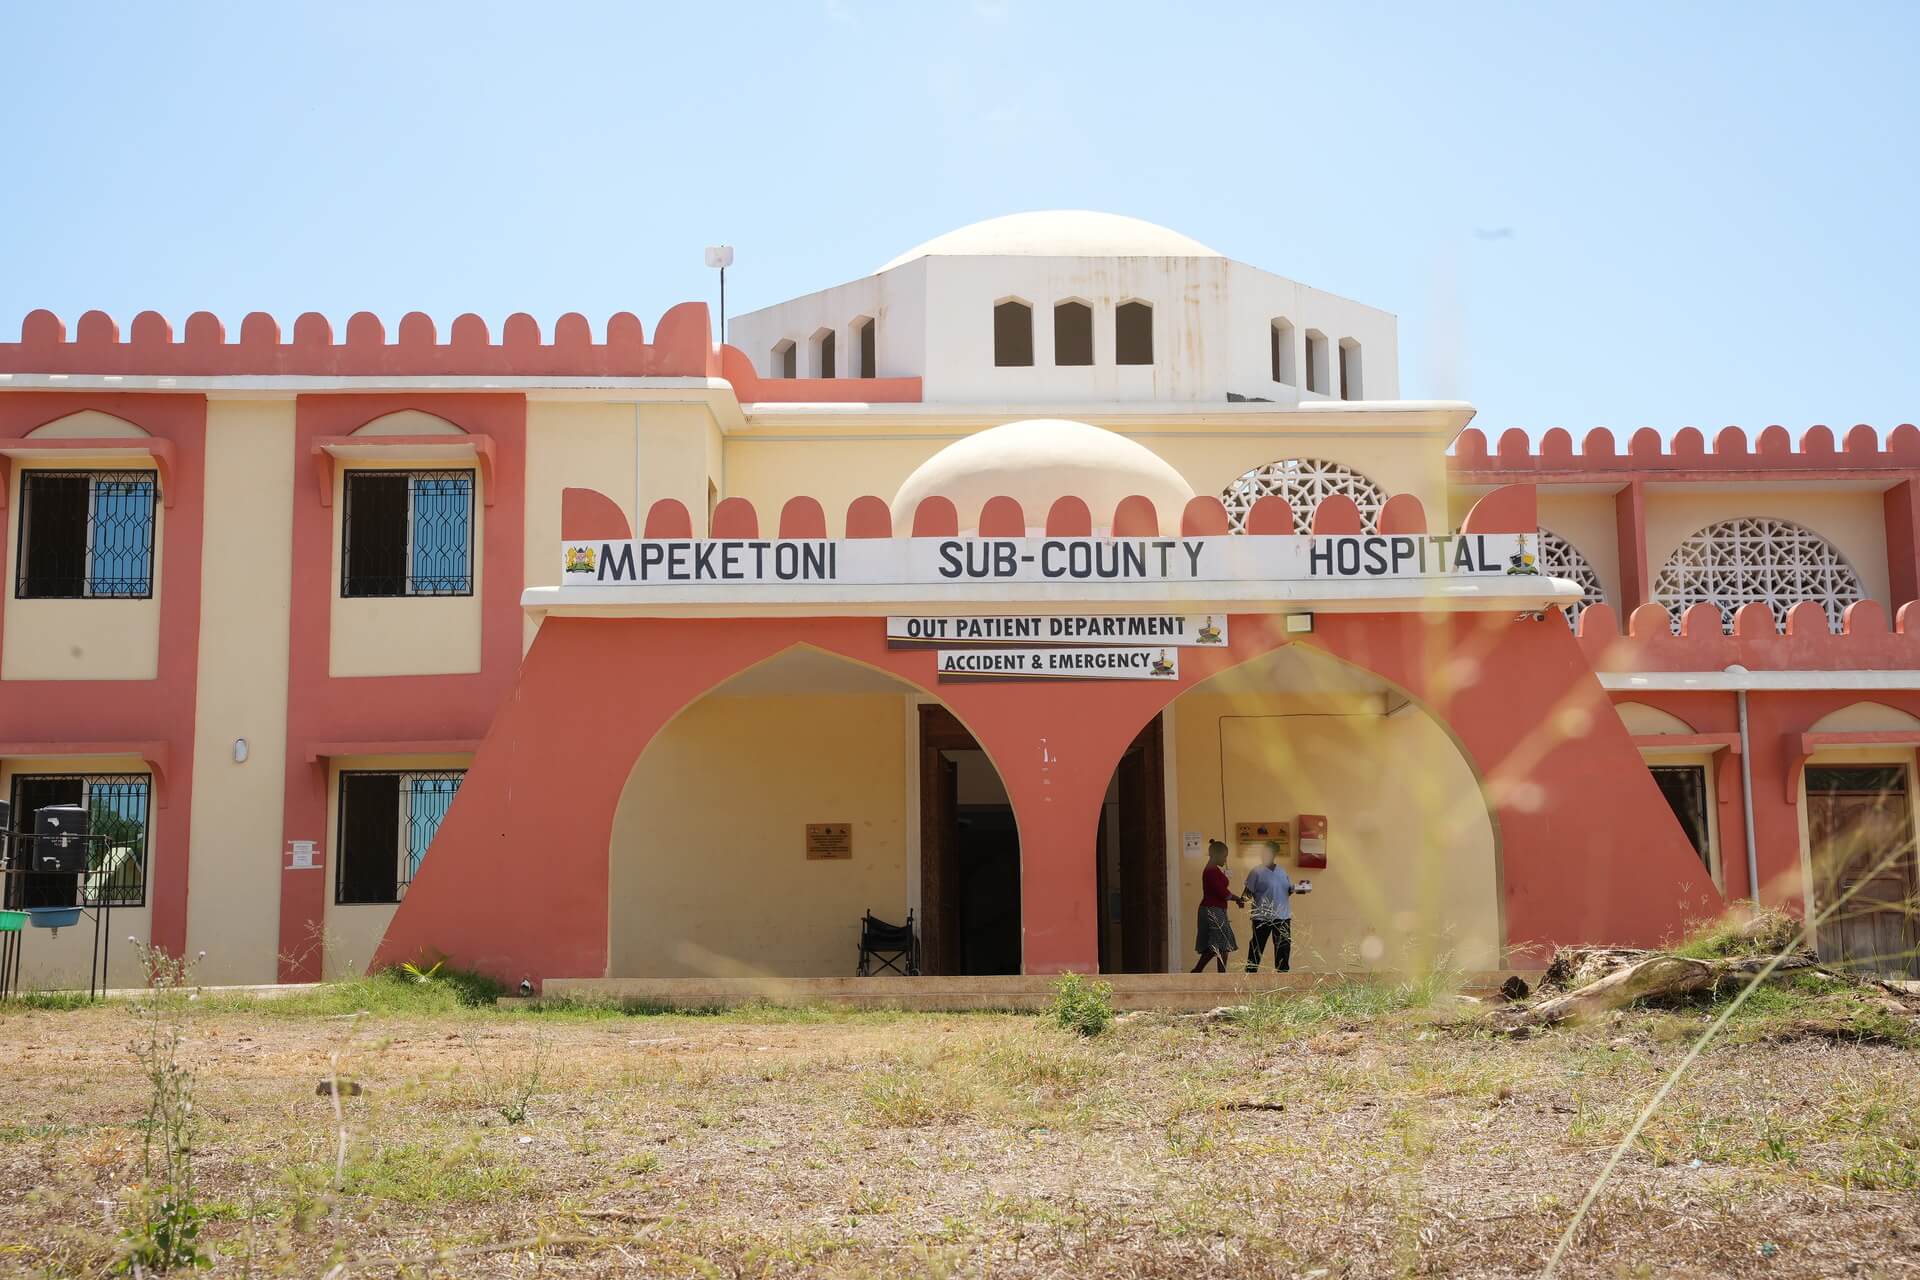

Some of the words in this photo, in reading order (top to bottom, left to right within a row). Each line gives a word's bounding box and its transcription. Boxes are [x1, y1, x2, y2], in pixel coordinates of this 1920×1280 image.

[597, 542, 837, 581] MPEKETONI
[938, 541, 1205, 579] SUB-COUNTY
[1310, 535, 1502, 576] HOSPITAL
[907, 618, 948, 637] OUT
[956, 618, 1042, 637] PATIENT
[1050, 616, 1186, 636] DEPARTMENT
[945, 655, 1025, 670] ACCIDENT
[1031, 654, 1043, 669] &
[1049, 653, 1151, 669] EMERGENCY
